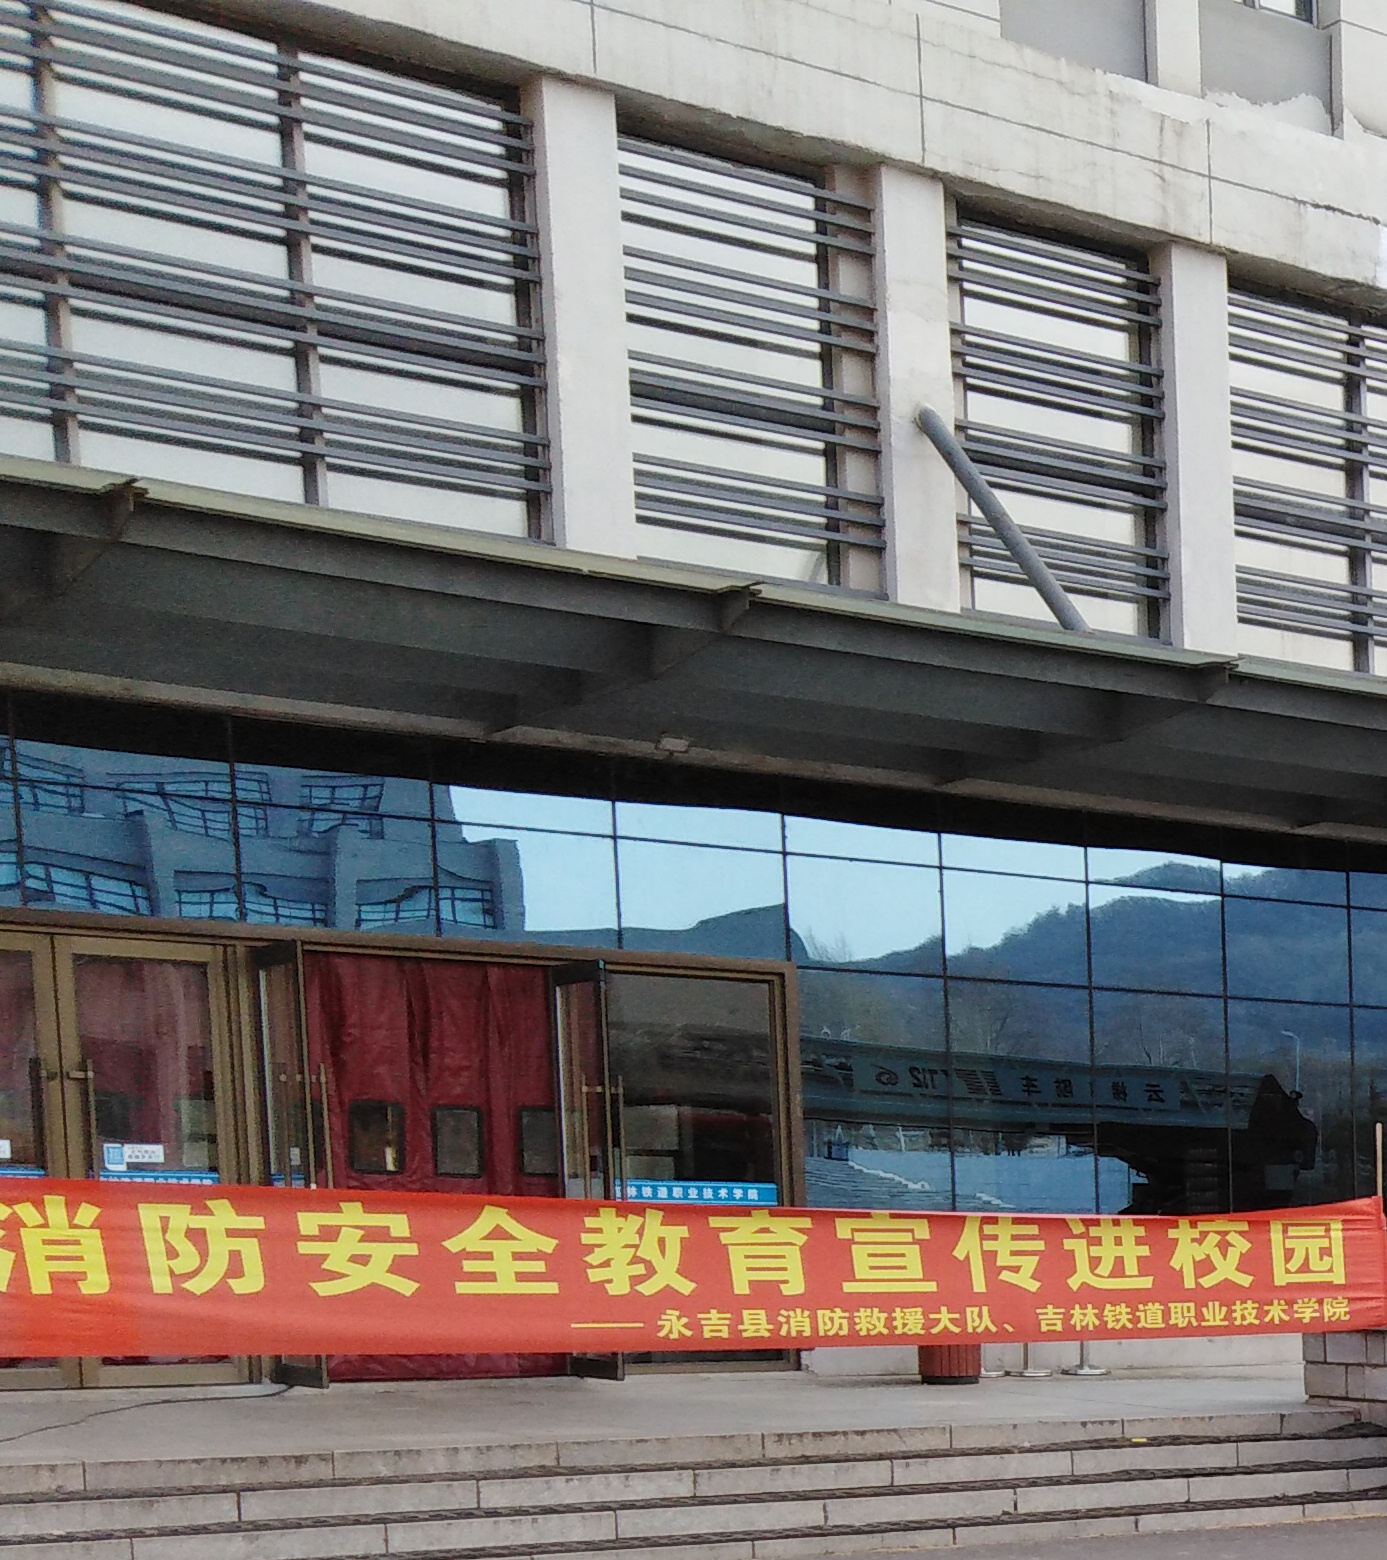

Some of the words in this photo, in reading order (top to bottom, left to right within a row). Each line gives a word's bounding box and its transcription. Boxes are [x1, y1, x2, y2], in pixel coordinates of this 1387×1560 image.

[0, 1194, 1347, 1297] 消防安全教育宣传进校园
